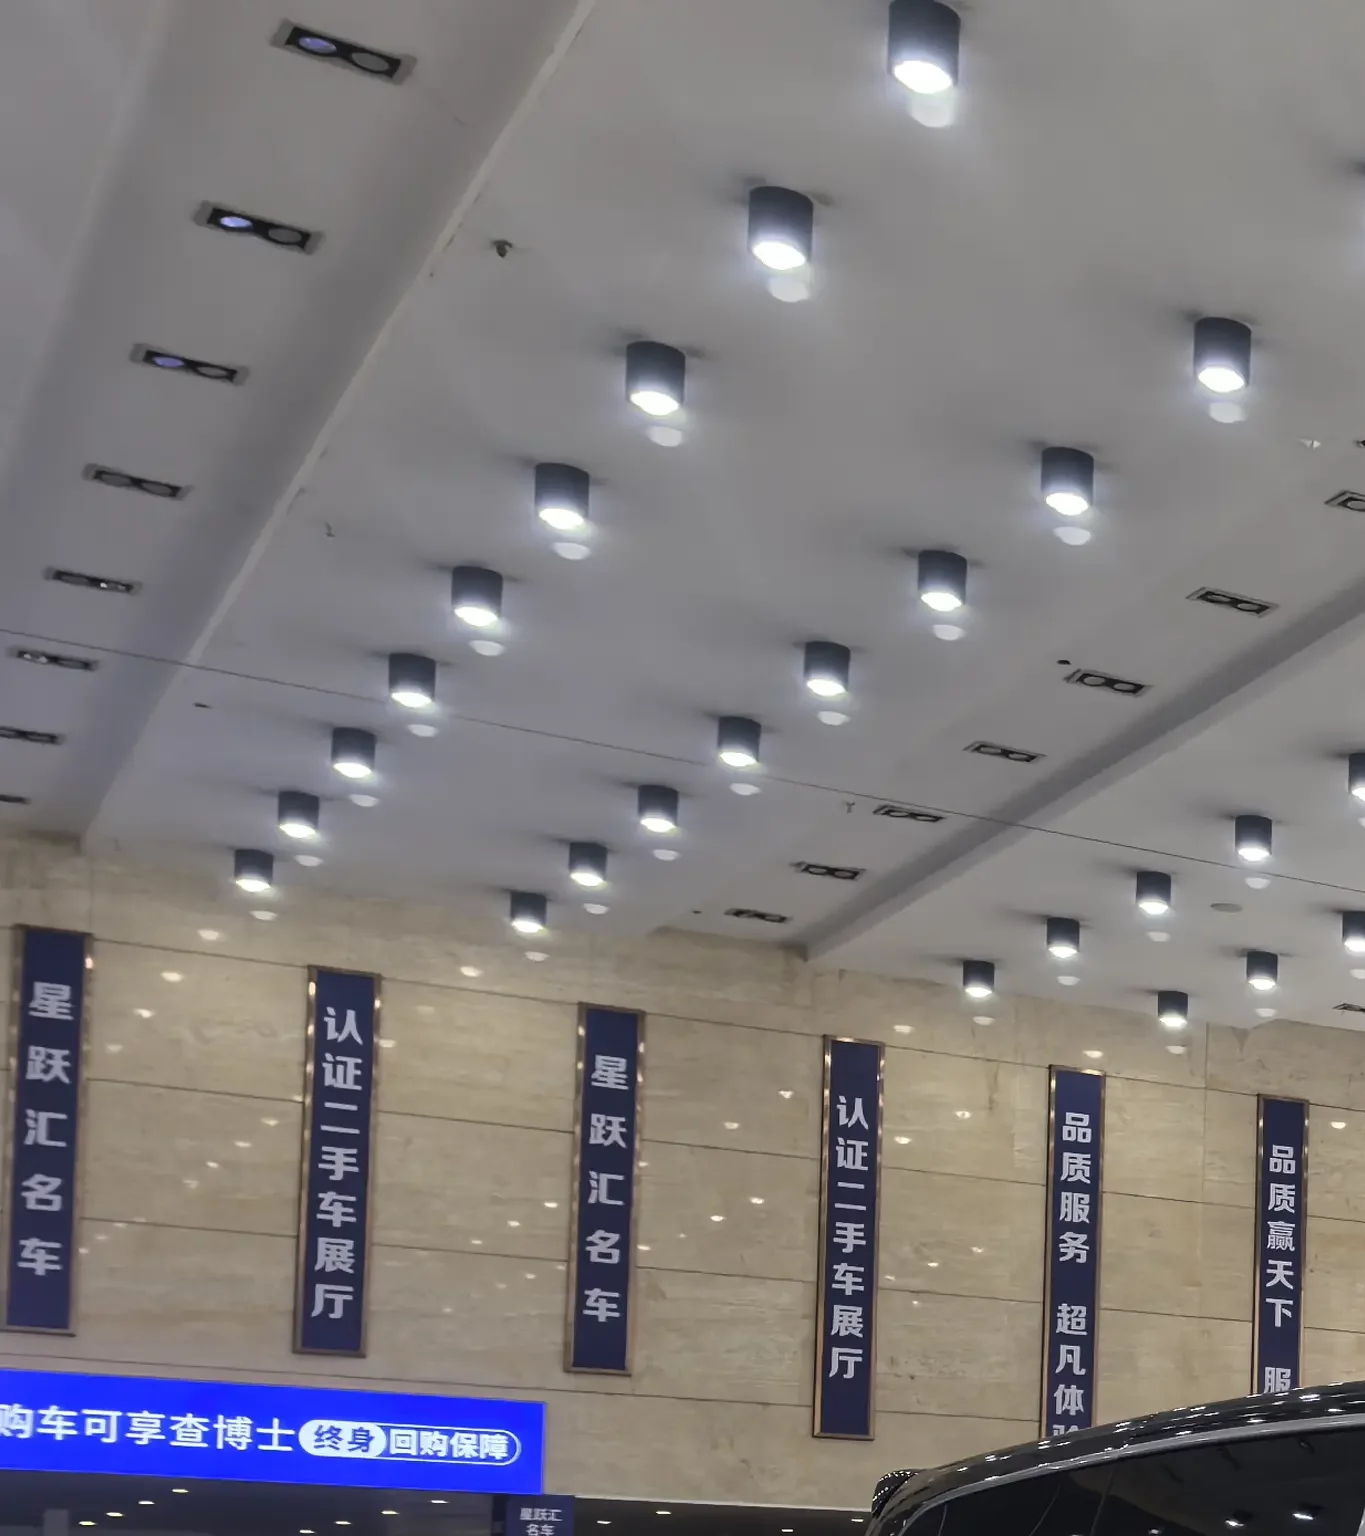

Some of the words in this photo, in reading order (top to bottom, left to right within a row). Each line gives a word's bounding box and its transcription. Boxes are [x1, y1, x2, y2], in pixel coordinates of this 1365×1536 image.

[18, 981, 74, 1278] 星跃汇名车
[310, 1007, 365, 1321] 认证二手车展厅
[583, 1054, 629, 1323] 星跃汇名车
[828, 1094, 870, 1381] 认证二手车展厅
[1058, 1111, 1093, 1264] 品质服务
[1265, 1144, 1297, 1328] 品质赢天下
[0, 1402, 296, 1452] 购车可享查博士
[313, 1423, 376, 1454] 终身
[389, 1428, 510, 1461] 回购保障
